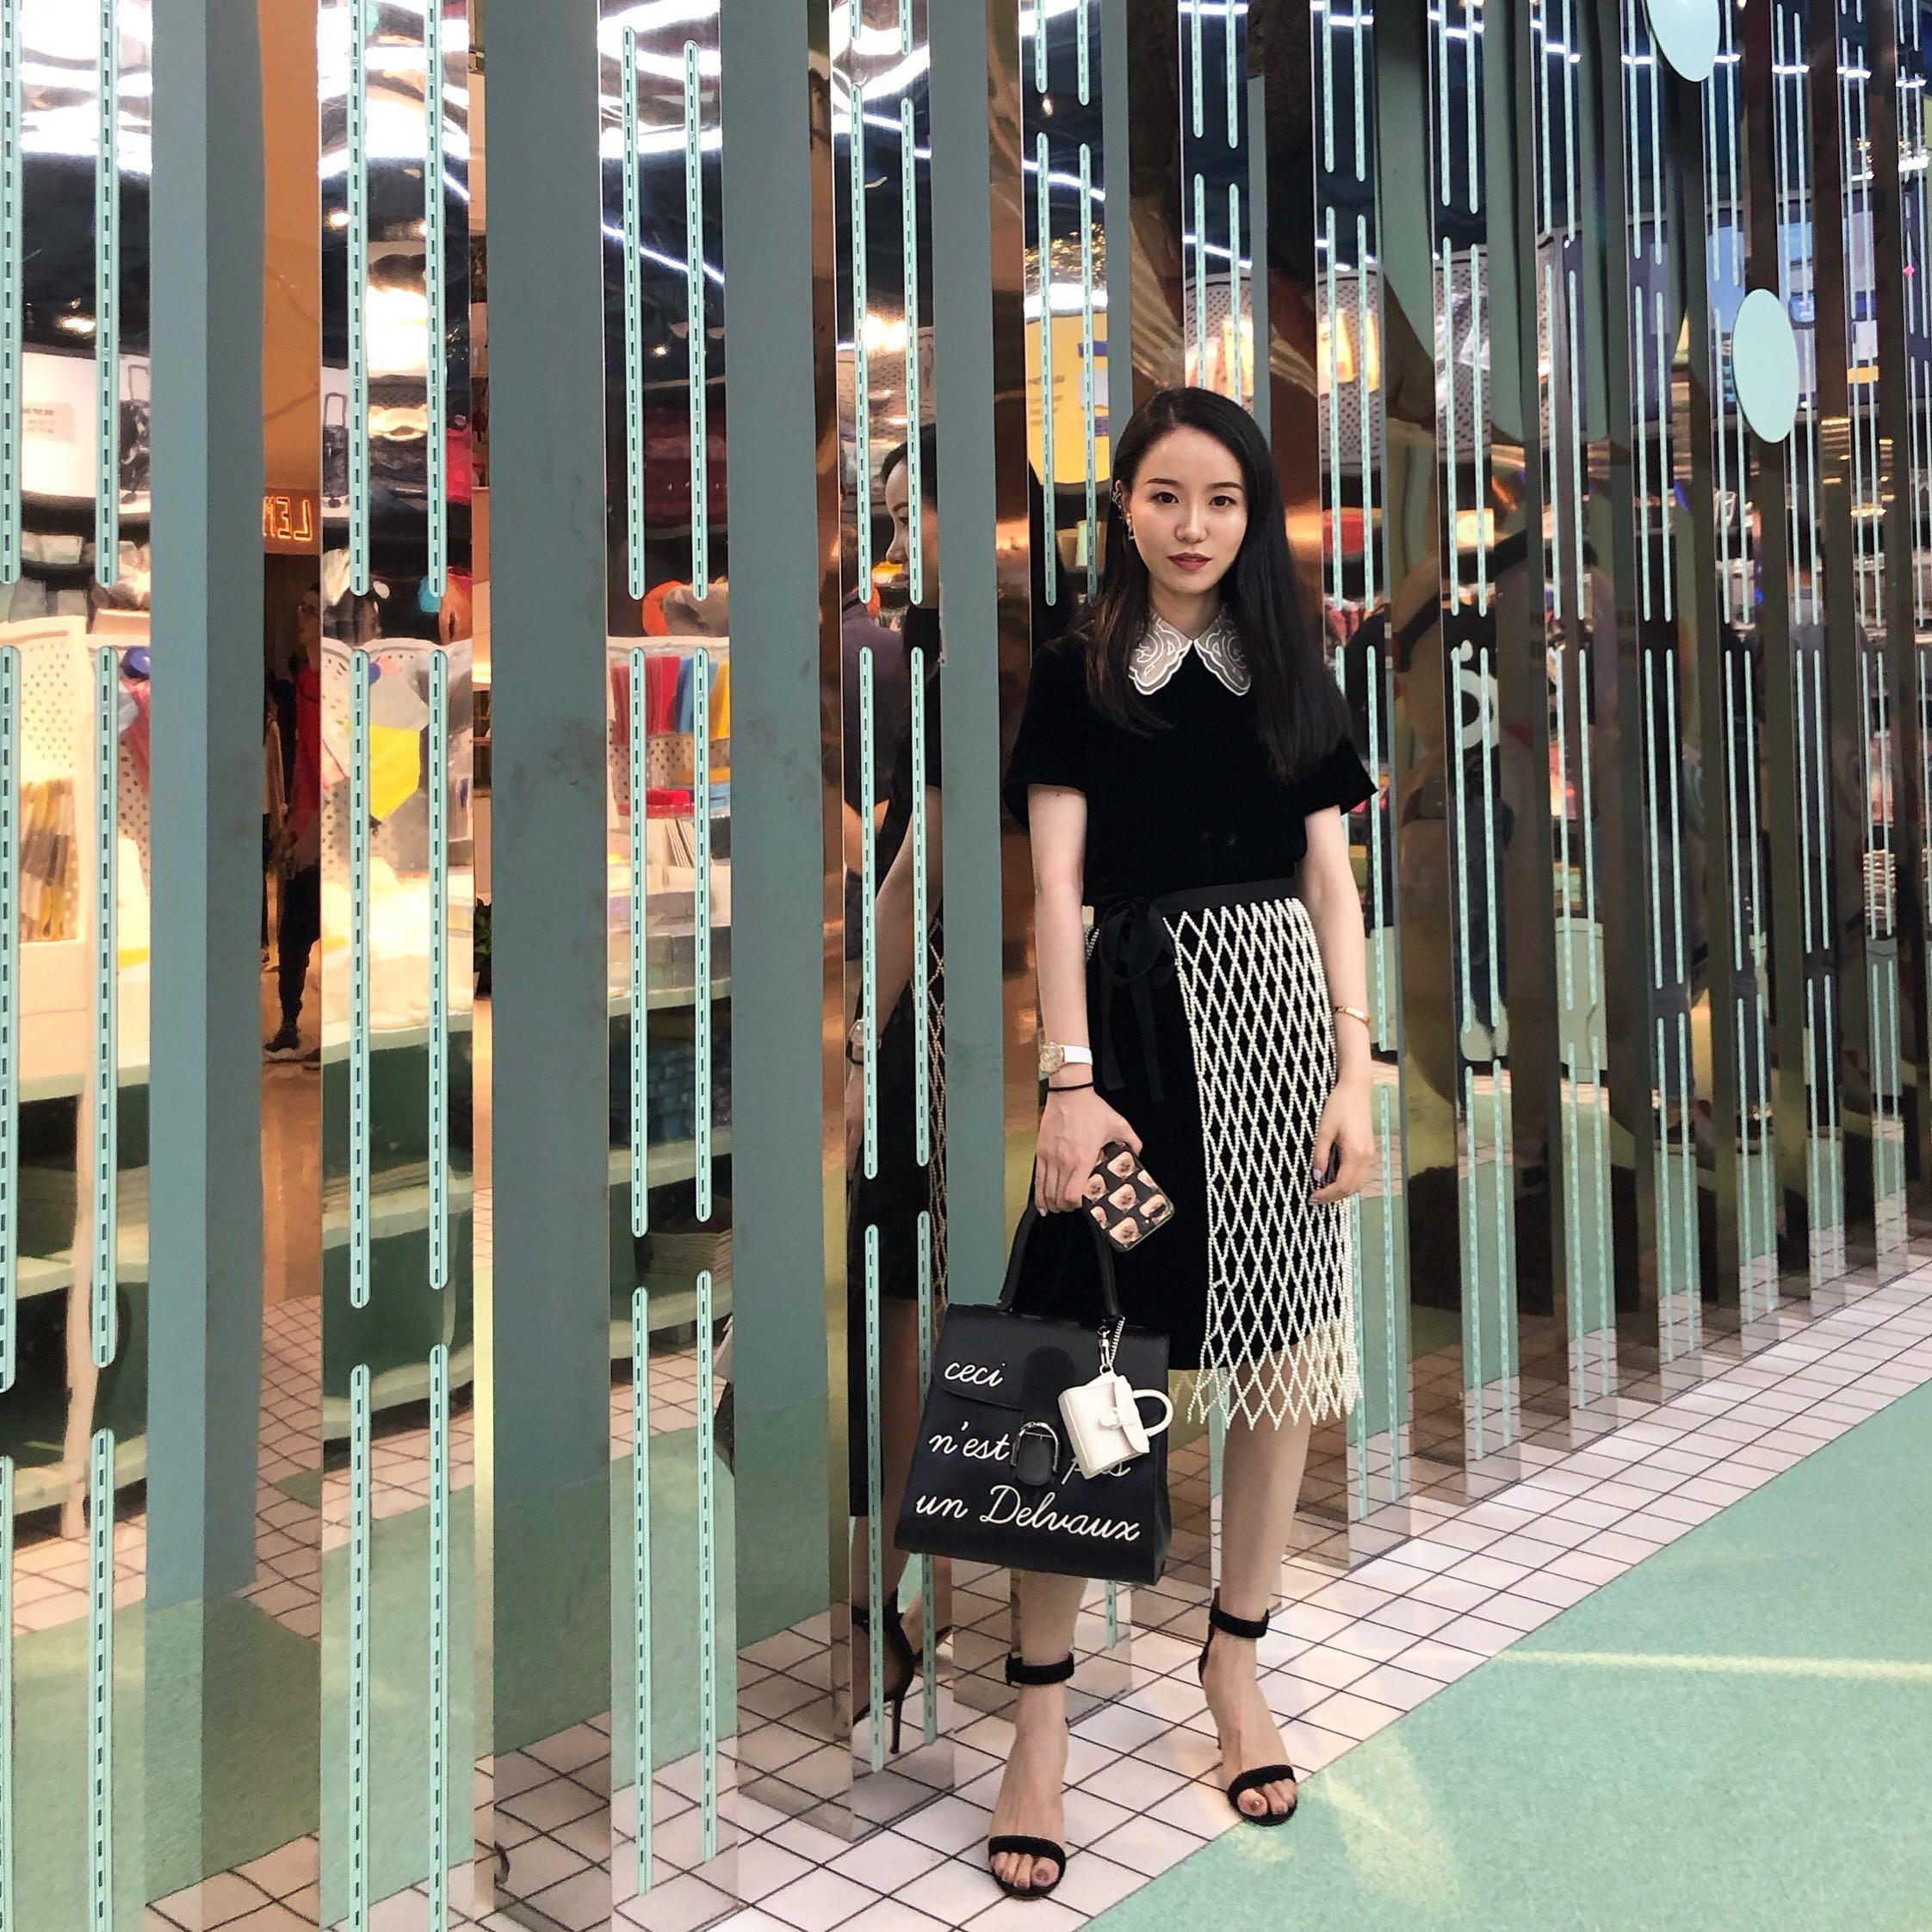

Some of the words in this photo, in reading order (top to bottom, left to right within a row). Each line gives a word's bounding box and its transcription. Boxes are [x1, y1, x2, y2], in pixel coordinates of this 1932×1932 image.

[944, 1362, 1006, 1388] ceci
[928, 1421, 1011, 1461] n'est
[915, 1494, 969, 1519] un
[979, 1483, 1141, 1541] Delvaux
